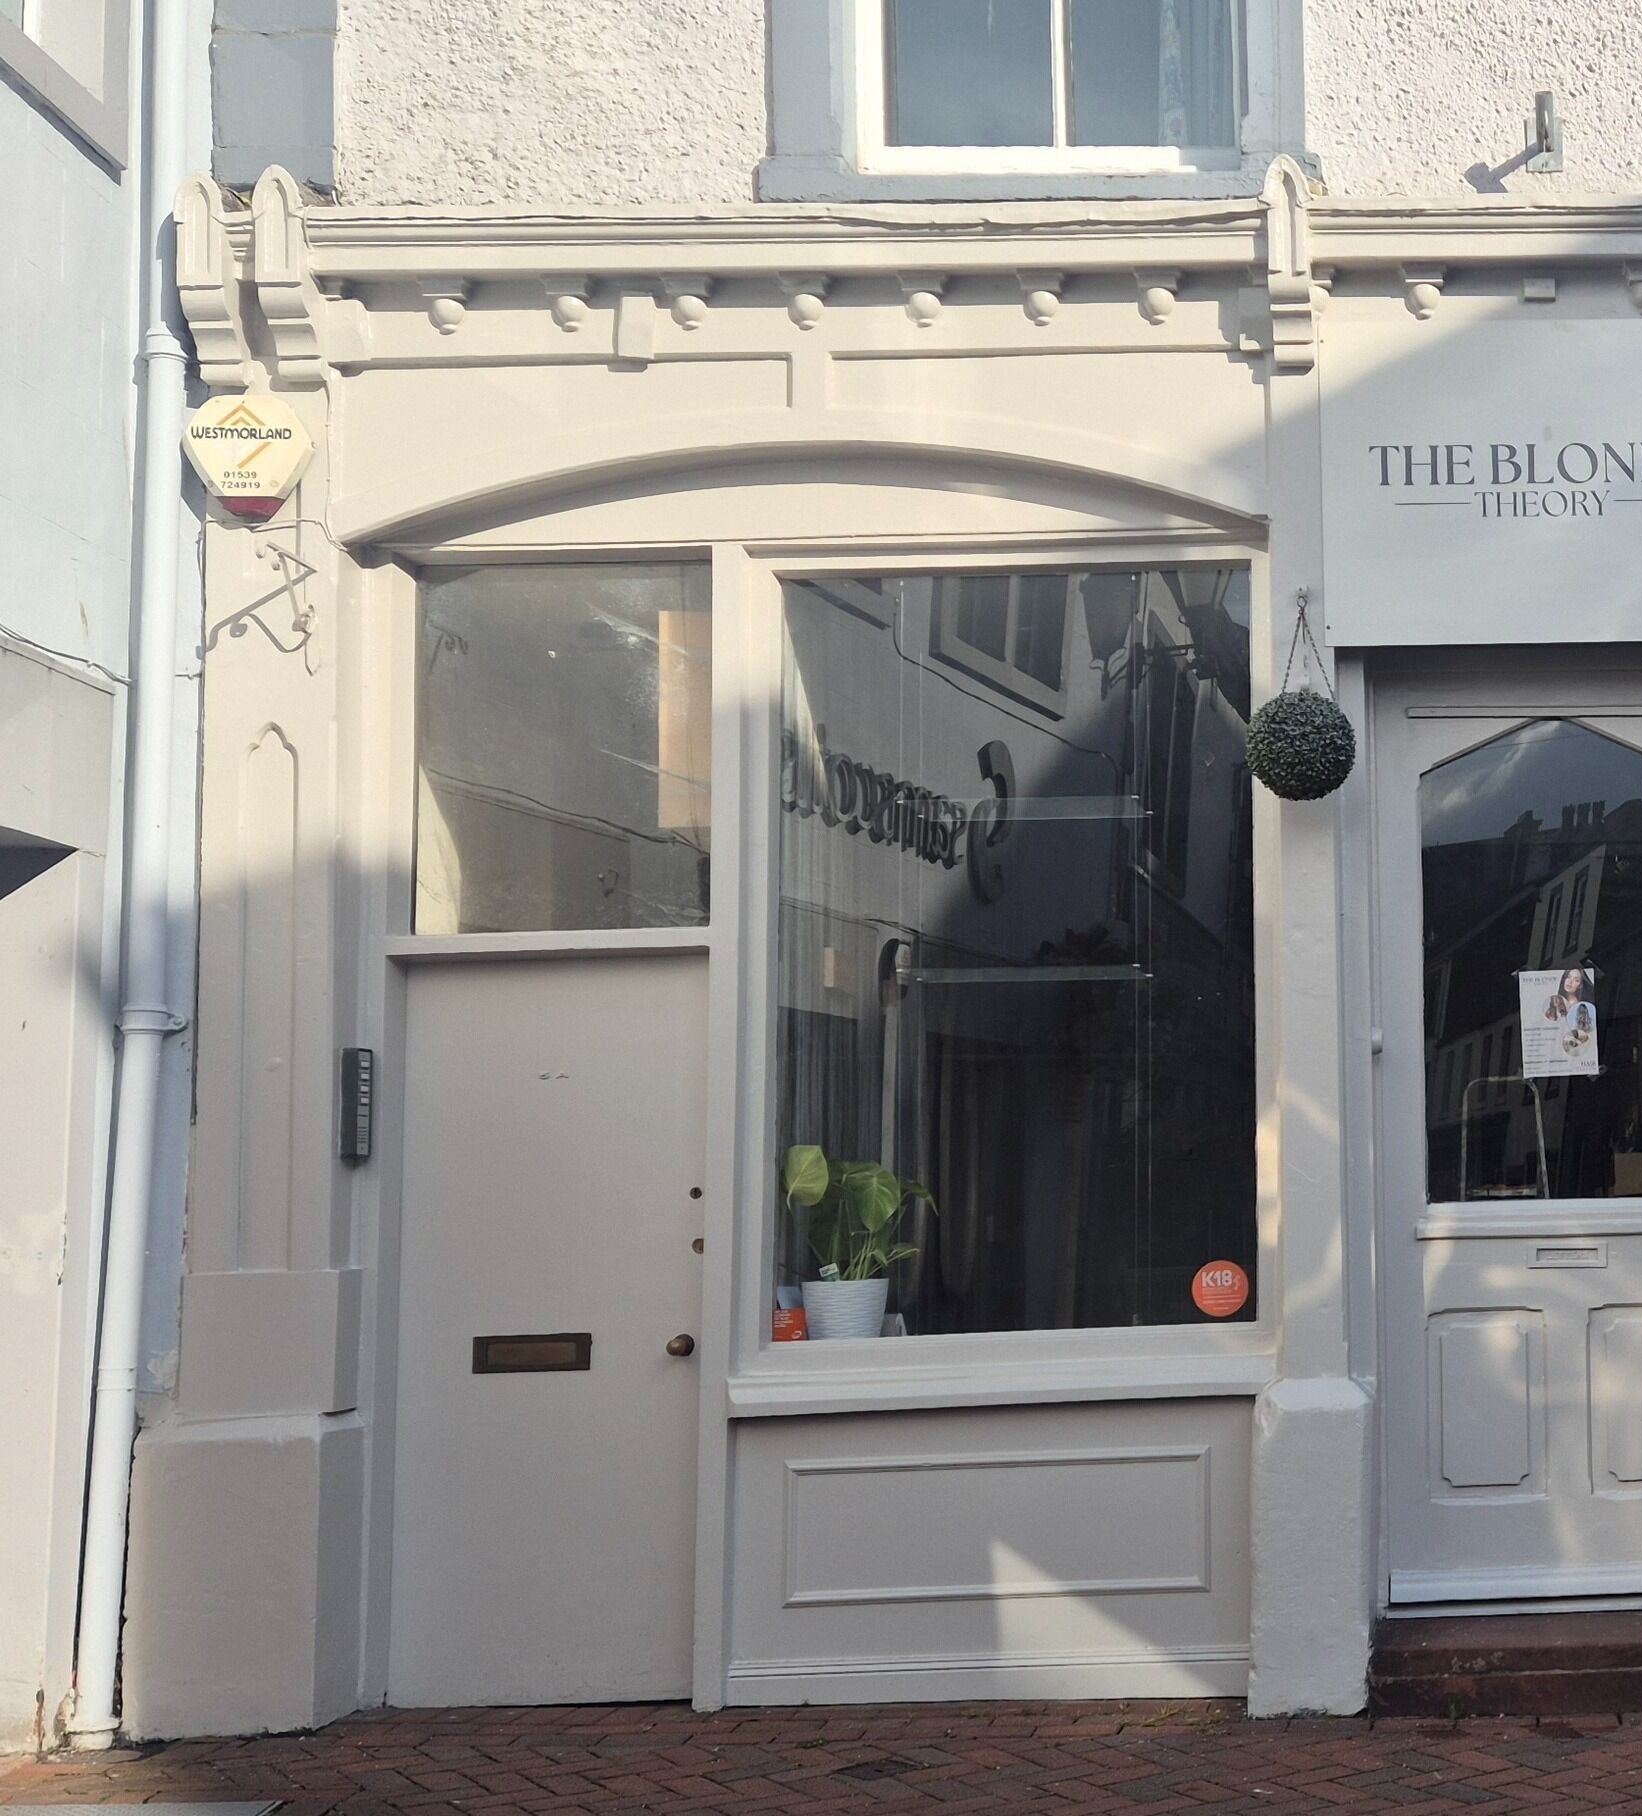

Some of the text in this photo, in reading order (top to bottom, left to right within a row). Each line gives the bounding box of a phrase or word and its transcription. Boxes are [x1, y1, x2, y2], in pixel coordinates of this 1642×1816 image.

[190, 426, 292, 440] WESTMORLAND
[1368, 444, 1475, 487] THE
[223, 471, 257, 479] 01539
[220, 481, 261, 489] 724919
[1474, 490, 1610, 518] THEORY
[1201, 1269, 1233, 1288] K18
